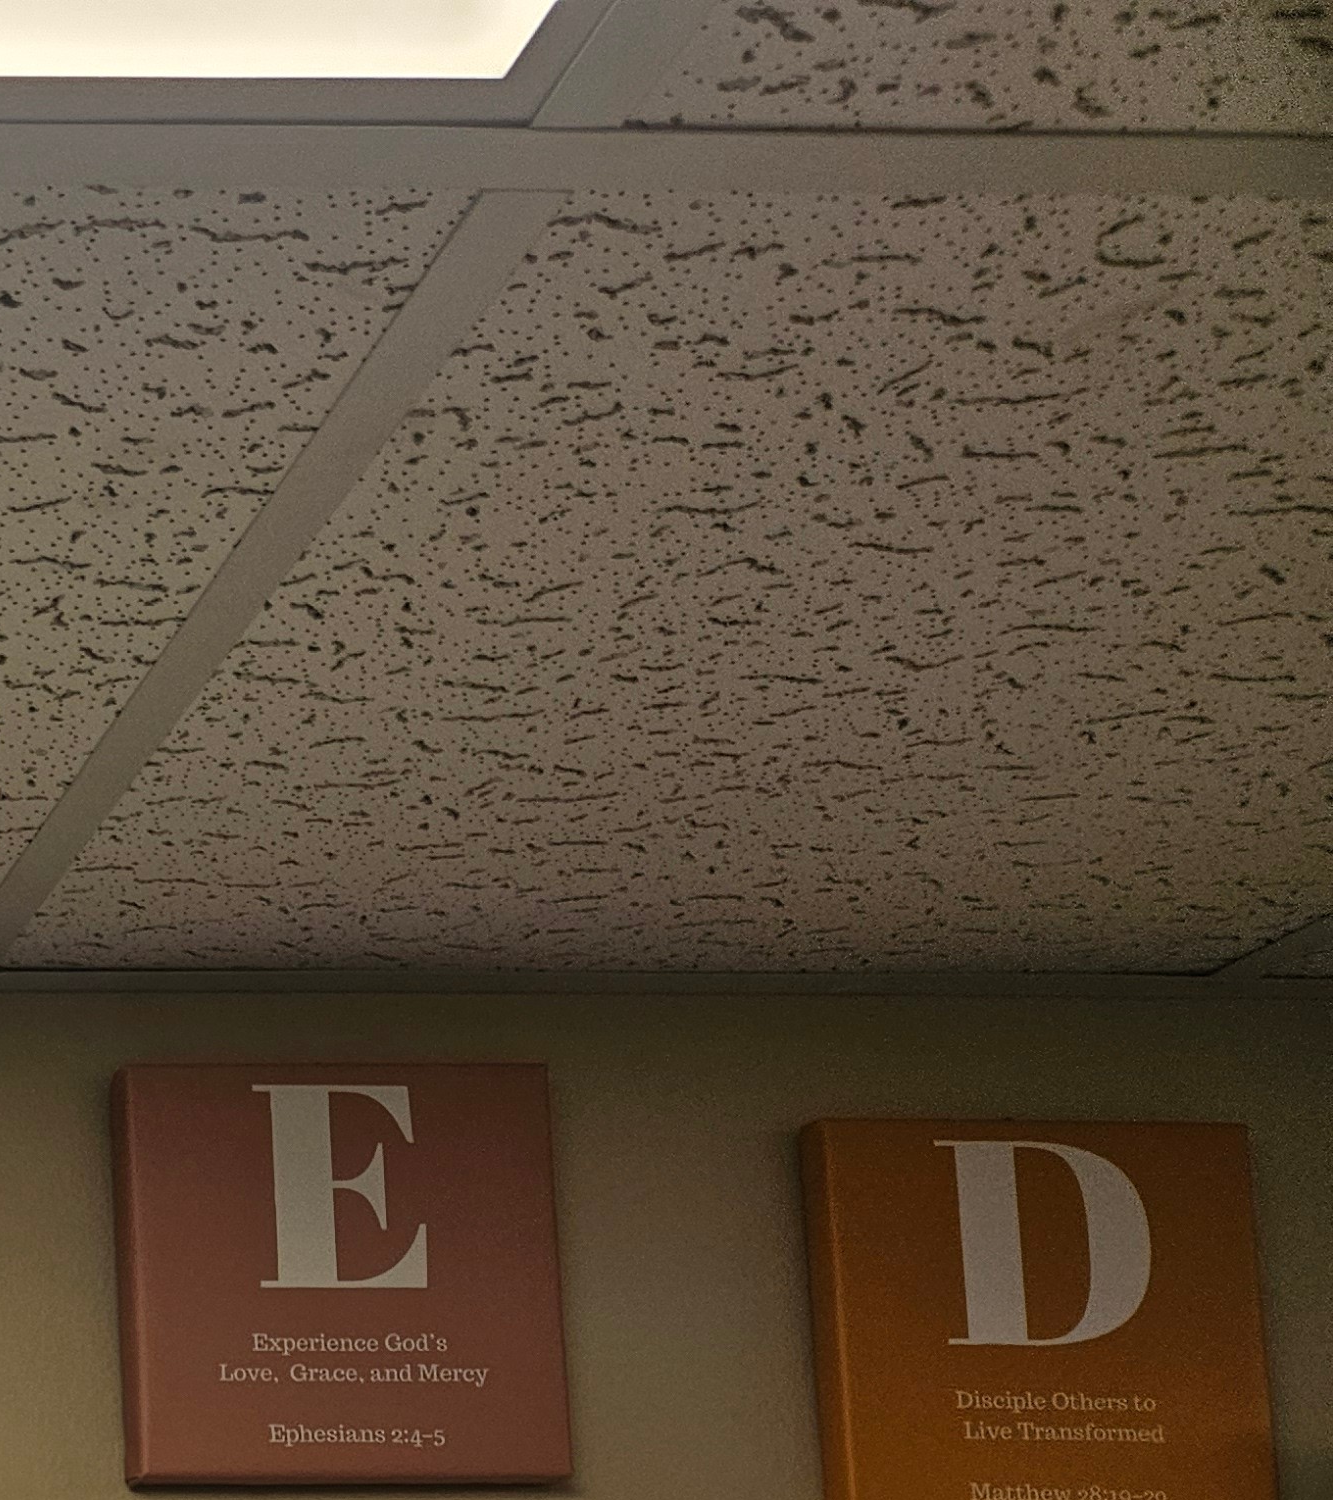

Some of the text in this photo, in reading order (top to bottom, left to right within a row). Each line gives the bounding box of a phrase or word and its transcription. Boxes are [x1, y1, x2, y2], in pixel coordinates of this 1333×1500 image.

[252, 1084, 427, 1288] E
[934, 1139, 1152, 1346] D
[252, 1333, 448, 1357] Experience God's
[220, 1364, 489, 1388] Love, Grace, and Mercy
[956, 1390, 1157, 1416] Disciple Others to
[269, 1424, 385, 1447] Ephesians
[963, 1422, 1165, 1443] Live Transformed
